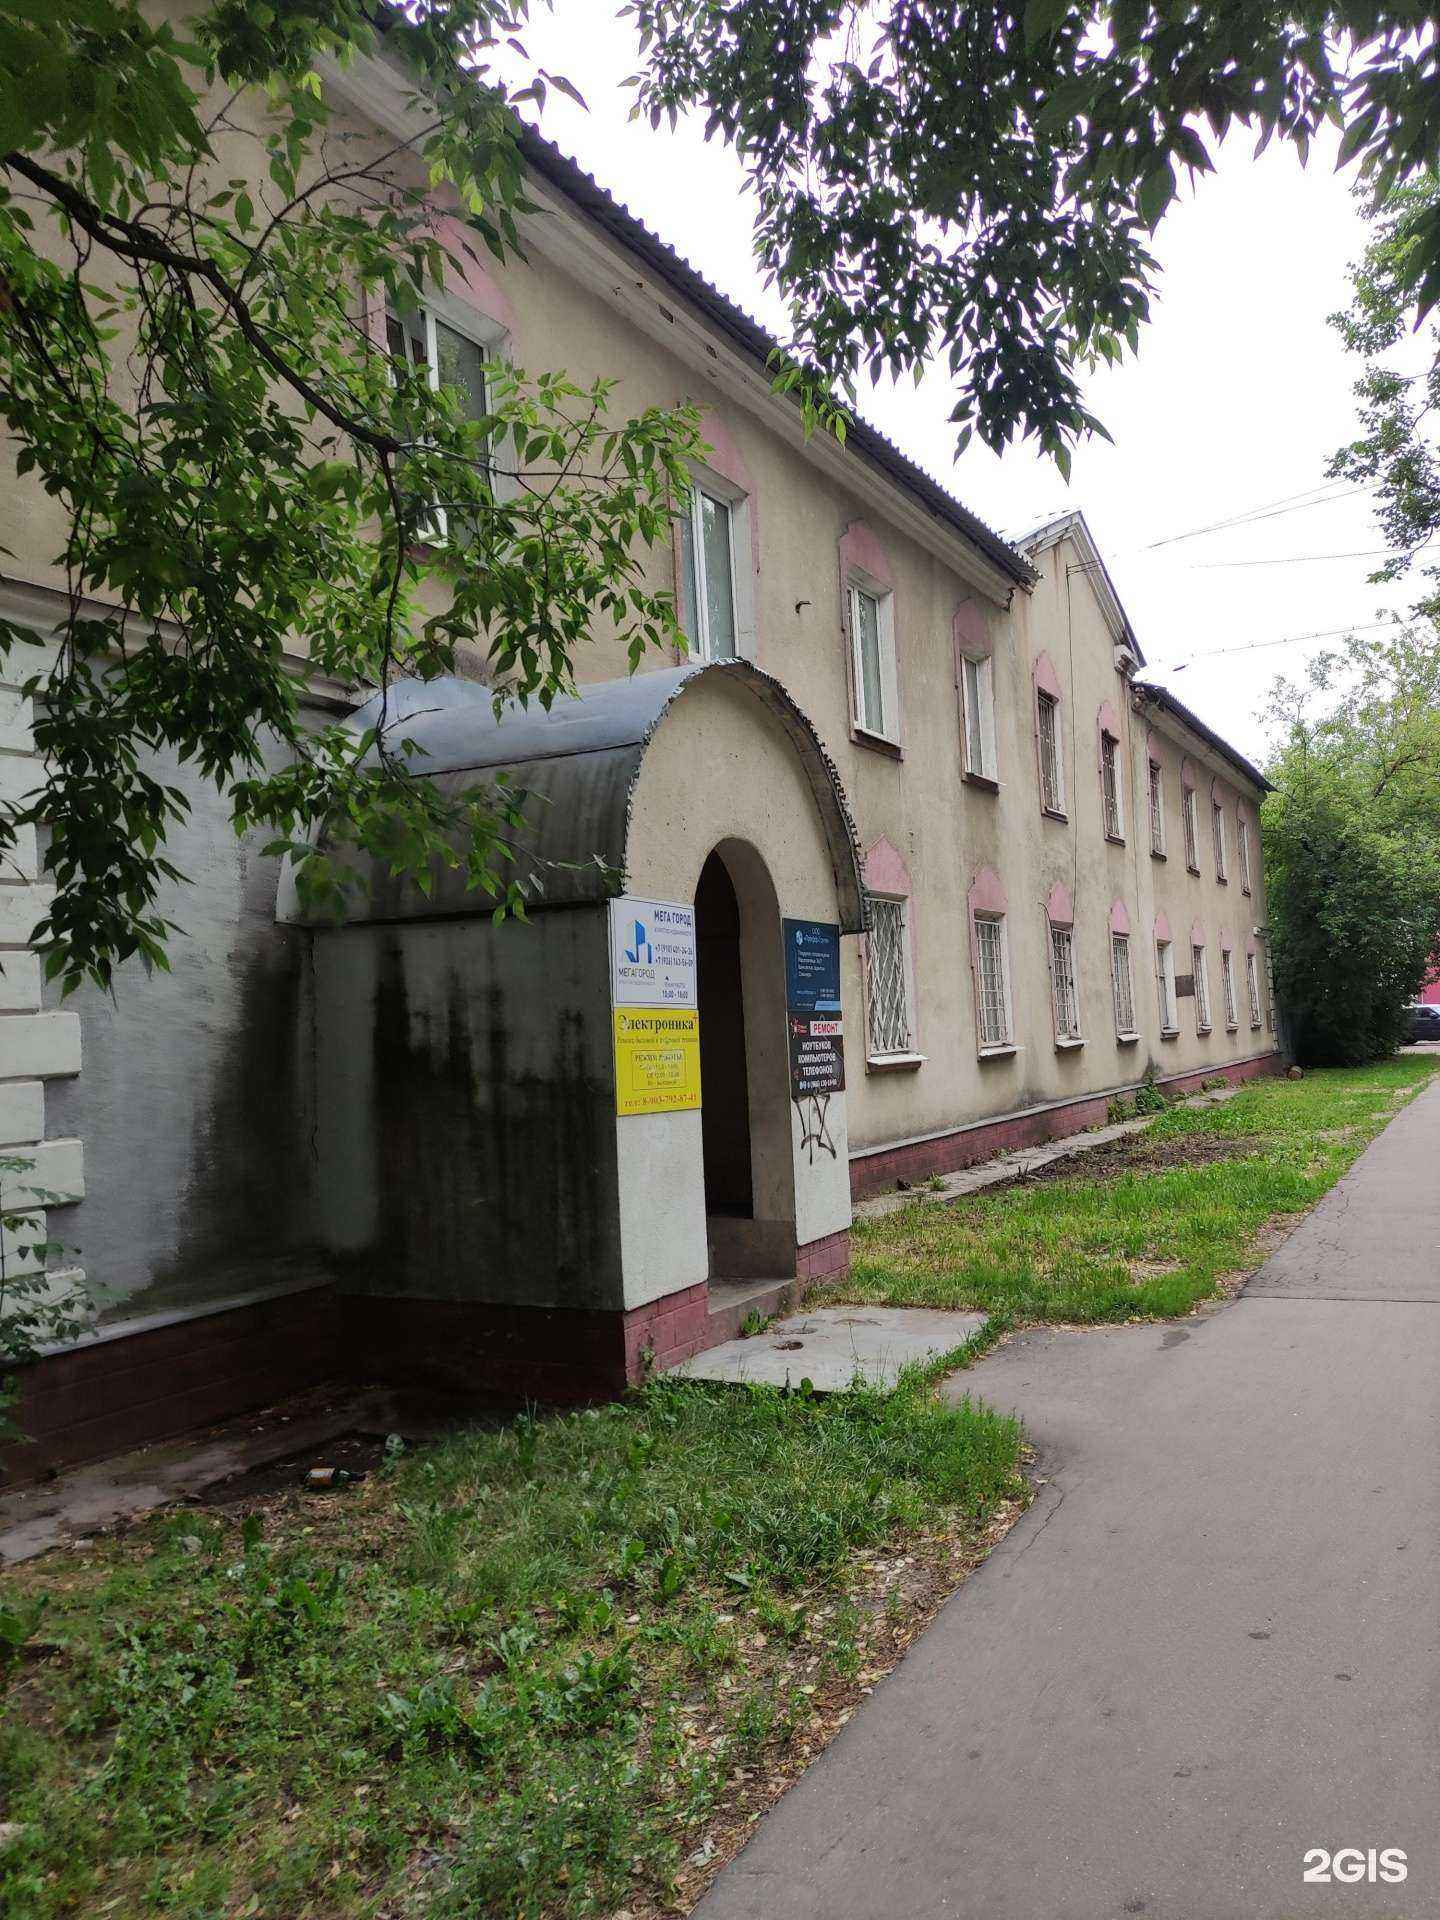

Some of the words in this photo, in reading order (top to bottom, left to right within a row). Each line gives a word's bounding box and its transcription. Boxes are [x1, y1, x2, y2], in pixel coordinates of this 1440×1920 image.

[654, 910, 670, 923] МЕГА
[672, 912, 692, 928] ГОРОД
[618, 968, 655, 978] МЕГАГОРОД
[813, 1023, 838, 1033] РЕМОНТ
[802, 1041, 832, 1051] НОУТБУКОВ
[798, 1053, 836, 1064] КОМПЬЮТЕРОВ
[803, 1065, 833, 1076] ТЕЛЕФОНОВ
